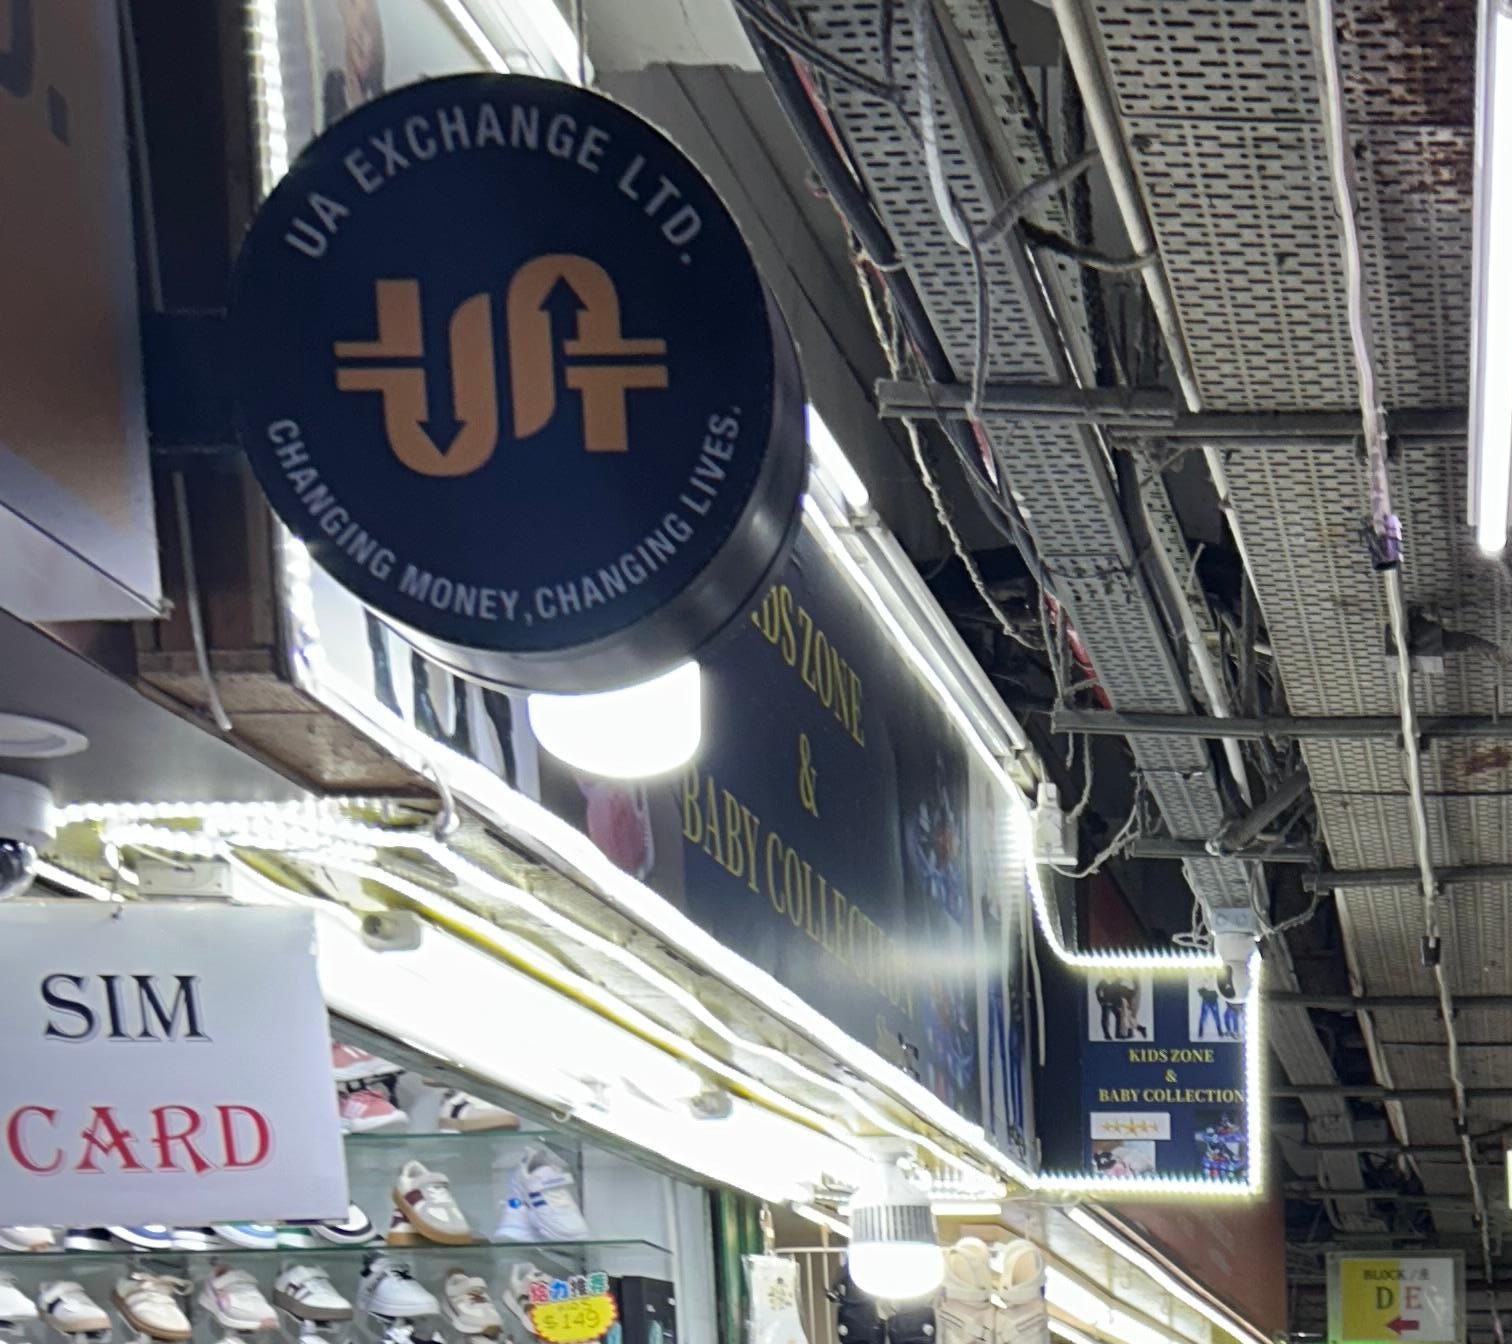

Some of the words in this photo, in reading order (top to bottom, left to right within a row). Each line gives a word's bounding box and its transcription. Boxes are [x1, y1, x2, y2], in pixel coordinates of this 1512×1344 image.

[285, 192, 351, 258] UA
[345, 104, 608, 193] EXCHANGE
[618, 153, 704, 265] LTD.
[267, 418, 398, 581] CHANGING
[536, 512, 695, 621] CHANGING
[682, 405, 744, 518] LIVES.
[751, 584, 795, 667] DS
[798, 608, 864, 747] ZONE
[799, 734, 819, 818] &
[683, 760, 761, 893] BABY
[766, 831, 913, 1020] COLLECTION
[41, 974, 206, 1040] SIM
[1129, 1049, 1168, 1063] KIDS
[1171, 1049, 1215, 1063] ZONE
[1164, 1069, 1178, 1083] &
[1099, 1088, 1139, 1103] BABY
[1143, 1088, 1245, 1103] COLLECTION
[6, 1105, 272, 1173] CARD
[1363, 1270, 1405, 1281] BLOCK
[1375, 1286, 1394, 1310] D
[1405, 1286, 1423, 1310] E
